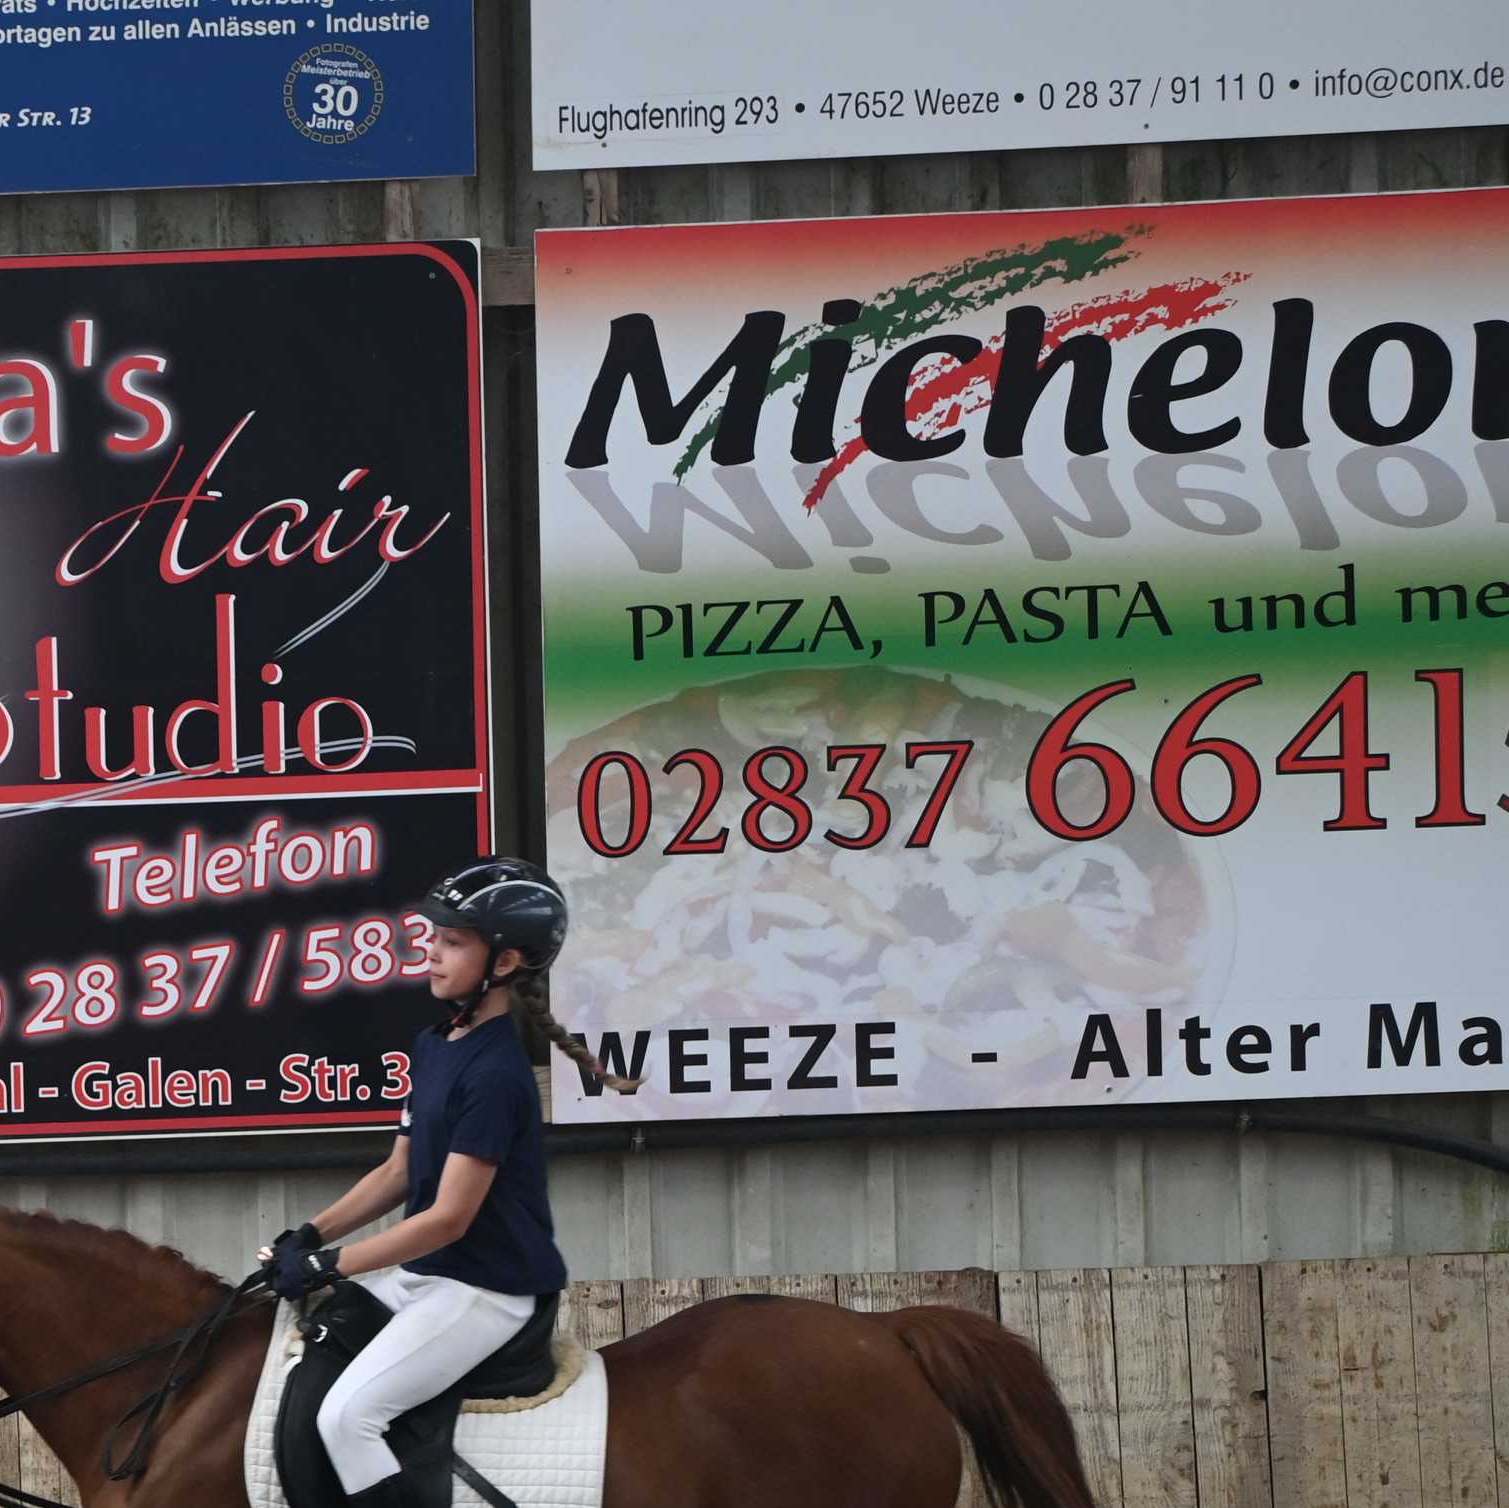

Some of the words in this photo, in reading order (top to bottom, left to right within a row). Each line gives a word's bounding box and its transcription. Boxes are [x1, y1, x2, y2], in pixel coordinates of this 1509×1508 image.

[89, 26, 115, 41] zu
[124, 20, 179, 40] allen
[187, 16, 295, 37] Anlässen
[327, 11, 429, 33] Industrie
[301, 64, 371, 79] Meisterbetrieb
[312, 84, 359, 116] 30
[559, 100, 725, 139] Flughafenring
[735, 96, 778, 125] 293
[820, 90, 904, 120] 47652
[915, 88, 999, 115] Weeze
[1040, 83, 1054, 110] 0
[1066, 81, 1097, 108] 28
[1109, 79, 1141, 107] 37
[1171, 76, 1199, 104] 91
[1216, 74, 1242, 101] 11
[1259, 72, 1273, 99] 0
[1315, 61, 1504, 98] info@conx.de
[70, 107, 91, 125] 13
[306, 114, 355, 132] Jahre
[55, 410, 449, 586] Hair
[626, 596, 882, 661] PIZZA,
[918, 581, 1173, 647] PASTA
[1208, 564, 1356, 633] und
[1395, 582, 1509, 623] me
[579, 740, 975, 858] 02837
[1024, 666, 1509, 842] 6641
[93, 817, 376, 913] Telefon
[22, 958, 118, 1037] 28
[140, 938, 234, 1019] 37
[69, 1055, 235, 1112] Galen
[279, 1050, 373, 1104] Str.
[577, 1020, 900, 1098] WEEZE
[1071, 1008, 1320, 1079] Alter
[1367, 1002, 1503, 1069] Ma
